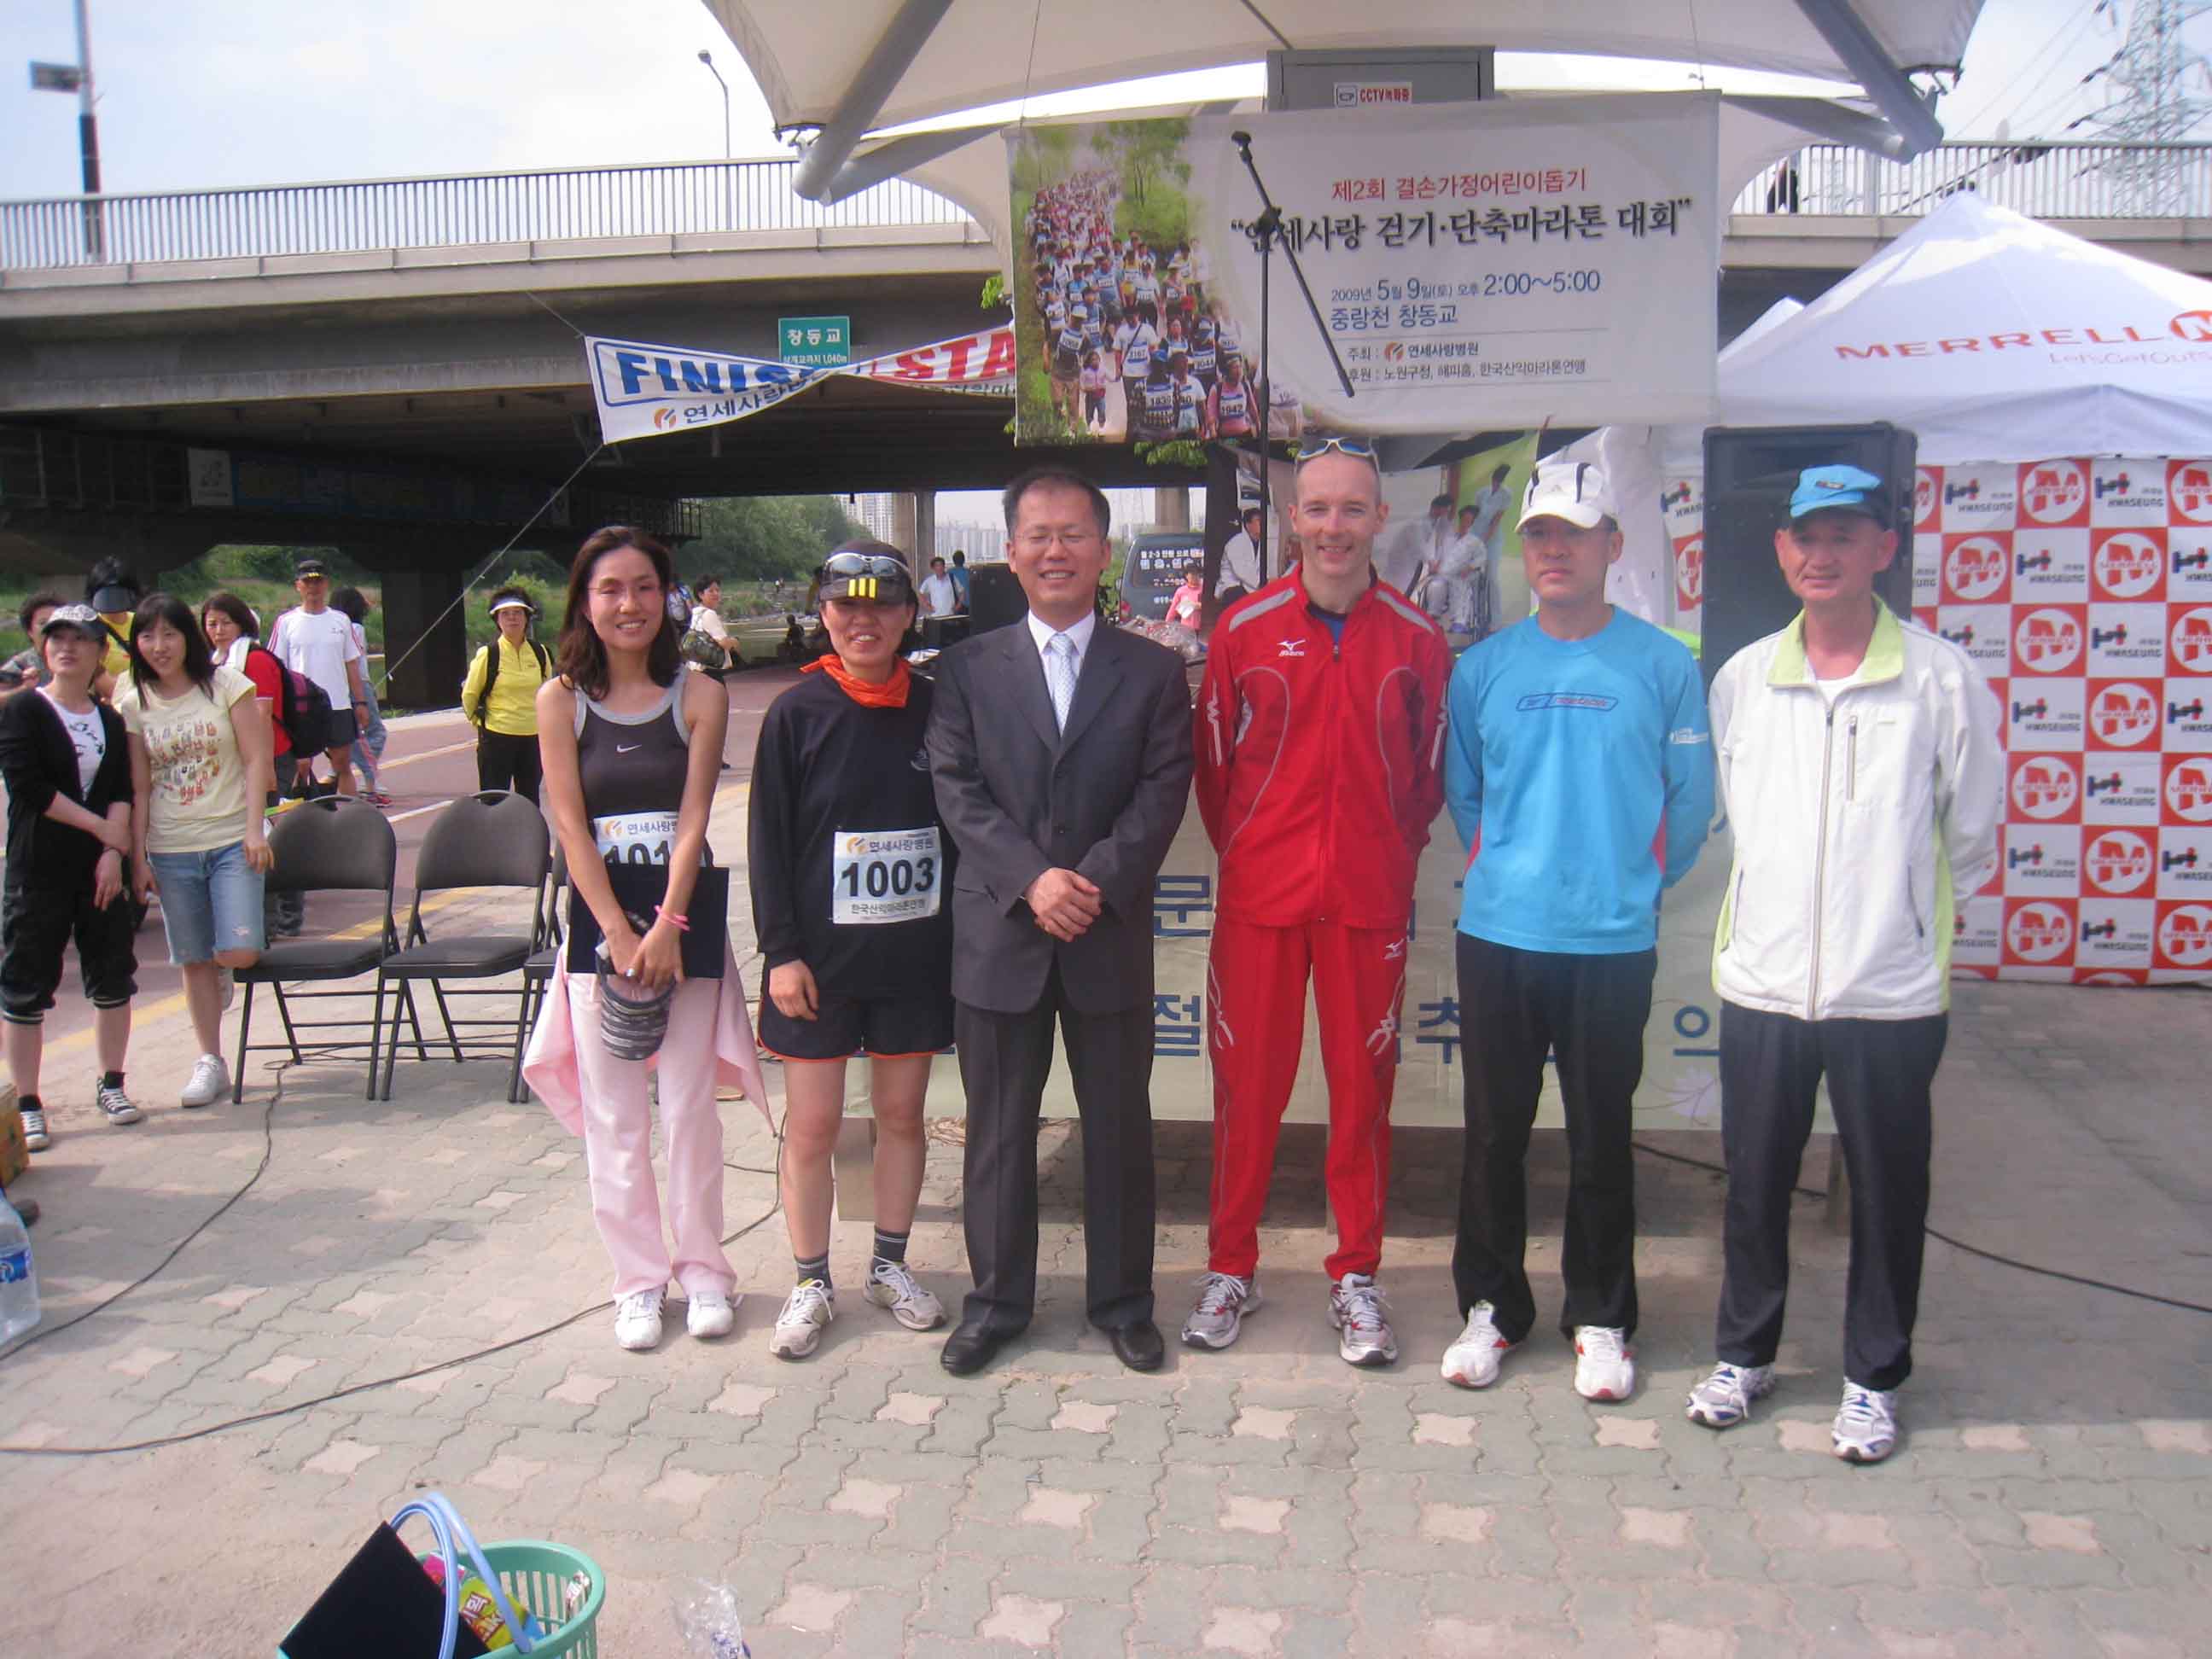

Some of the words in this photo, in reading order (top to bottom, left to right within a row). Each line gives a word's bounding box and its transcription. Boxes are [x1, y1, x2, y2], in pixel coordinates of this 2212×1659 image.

[1331, 178, 1384, 202] 제2회
[1396, 168, 1587, 200] 결손가정어린이돕기
[1331, 286, 1371, 301] 2009년
[1377, 279, 1401, 300] 5월
[1407, 277, 1452, 300] 9일(토)
[1458, 282, 1479, 296] 오후
[1330, 306, 1390, 331] 중랑천
[1399, 303, 1458, 328] 창동교
[787, 329, 841, 346] 창동교
[1409, 342, 1479, 358] 연세사랑병원
[1835, 326, 2164, 360] MERRELL
[869, 837, 934, 853] 연세사랑병원
[841, 857, 934, 898] 1003
